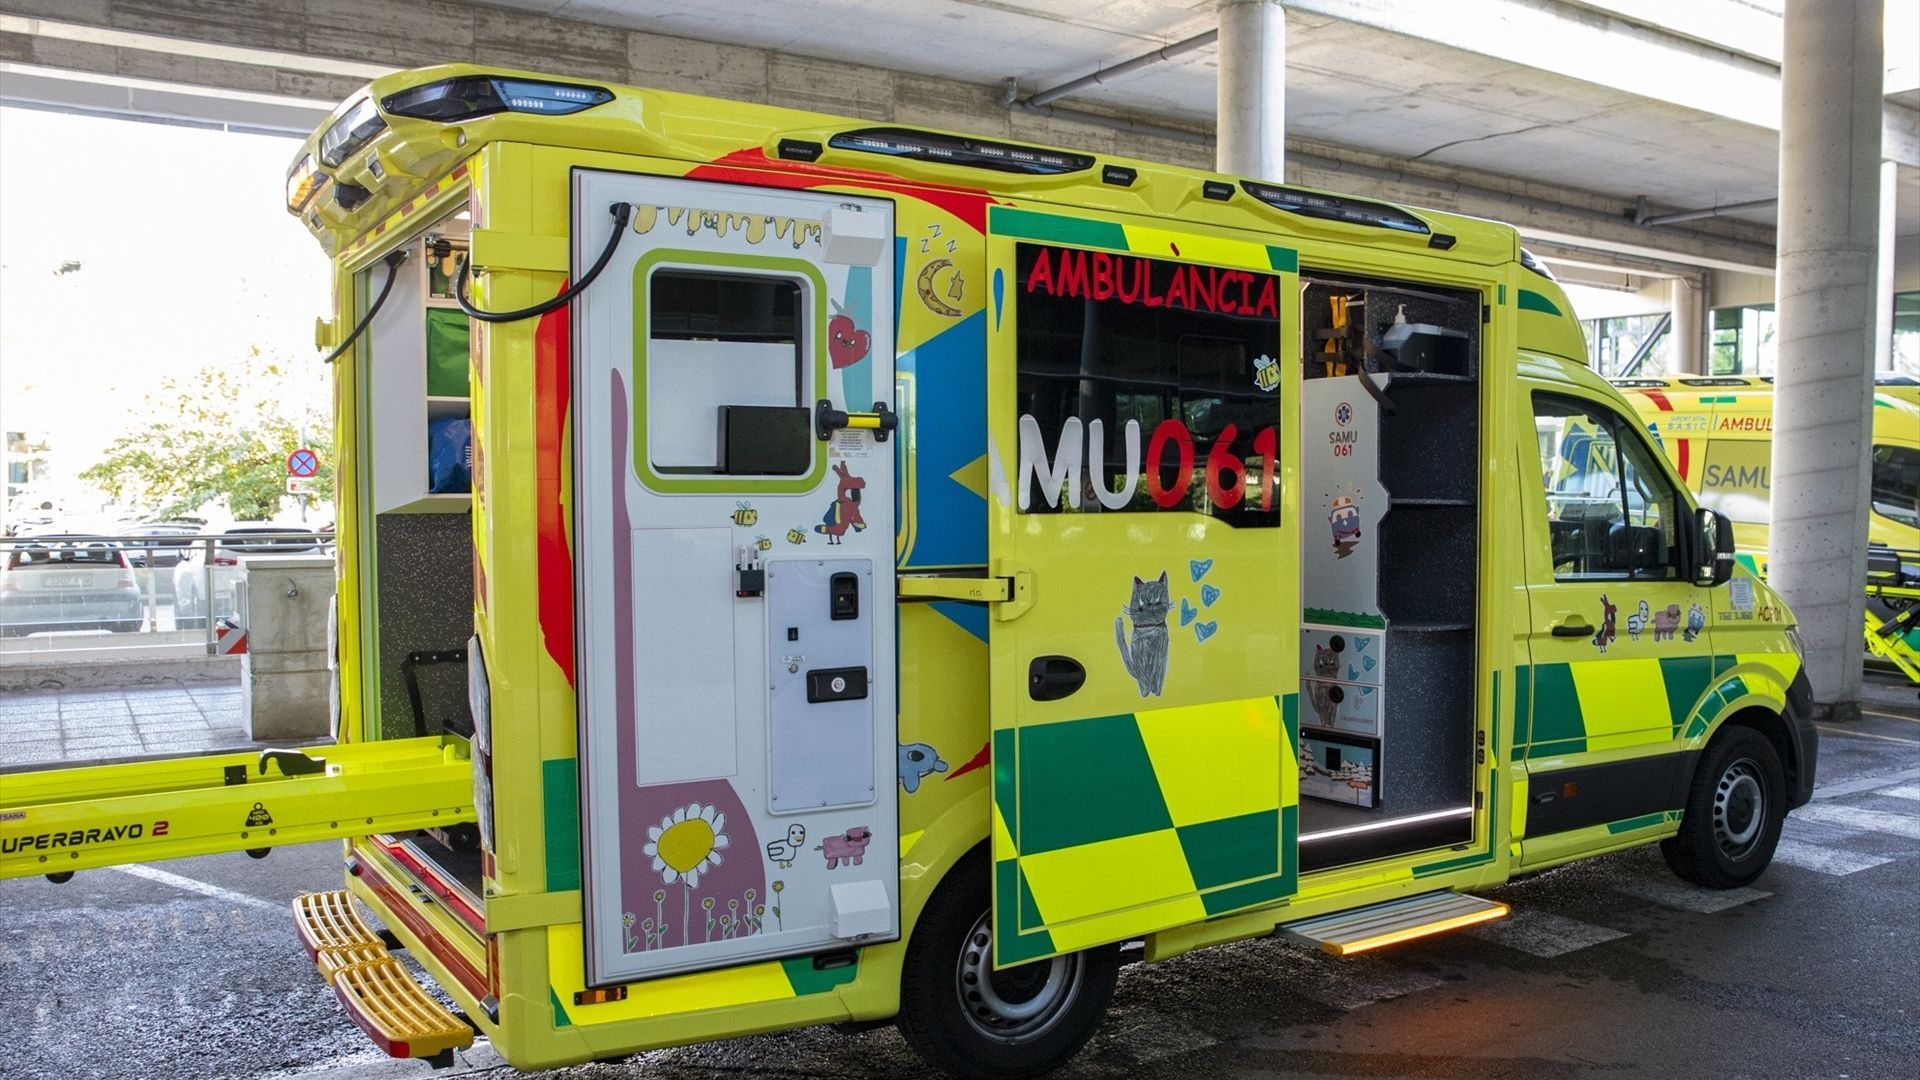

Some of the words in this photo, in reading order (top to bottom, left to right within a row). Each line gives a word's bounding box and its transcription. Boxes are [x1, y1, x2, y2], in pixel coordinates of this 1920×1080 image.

[1329, 430, 1358, 444] SAMU
[1334, 444, 1352, 456] 061
[989, 414, 1141, 510] MU
[2, 823, 143, 853] UPERBRAVO
[152, 821, 169, 836] 2
